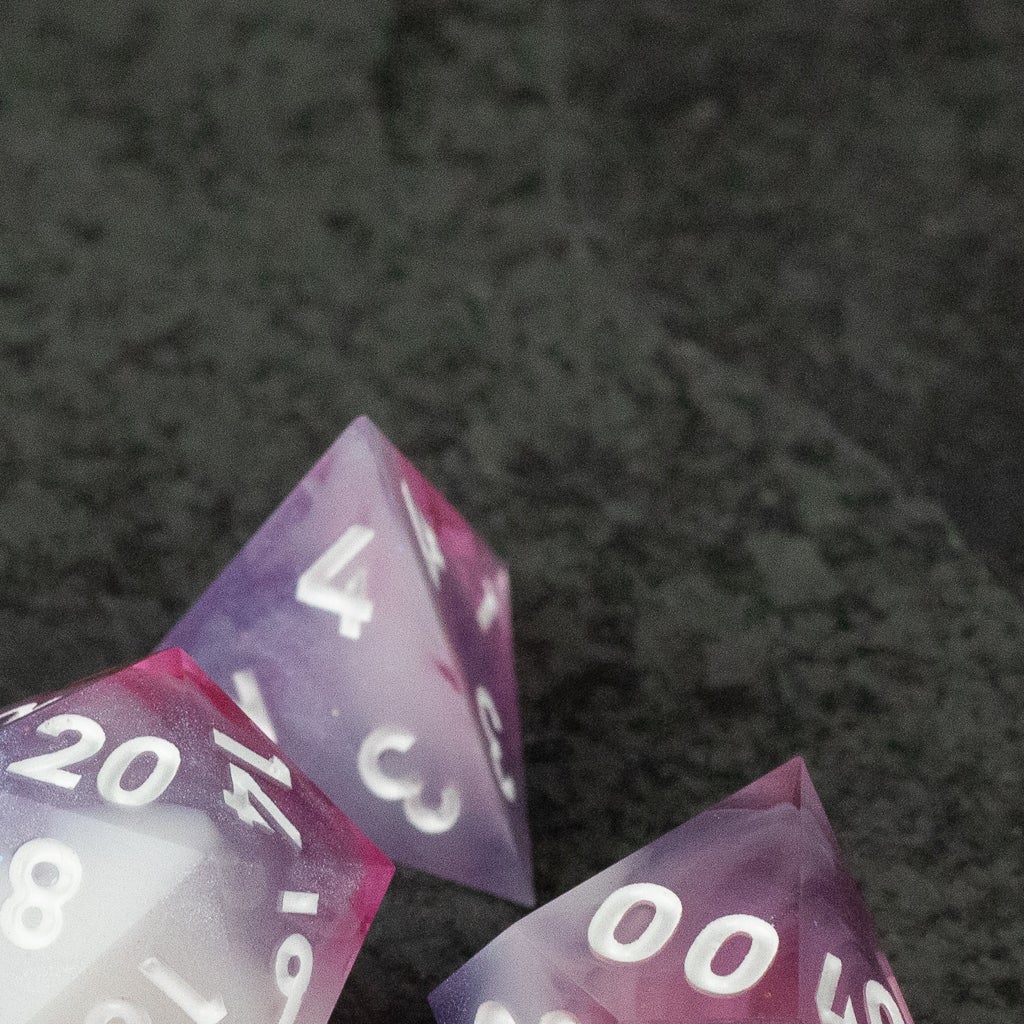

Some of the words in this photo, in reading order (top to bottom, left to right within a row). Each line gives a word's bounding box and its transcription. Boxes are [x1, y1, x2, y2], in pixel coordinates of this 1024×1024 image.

[294, 524, 375, 640] 4
[7, 714, 181, 806] 20
[358, 728, 462, 834] 3
[0, 837, 83, 950] 8
[587, 882, 780, 996] 00
